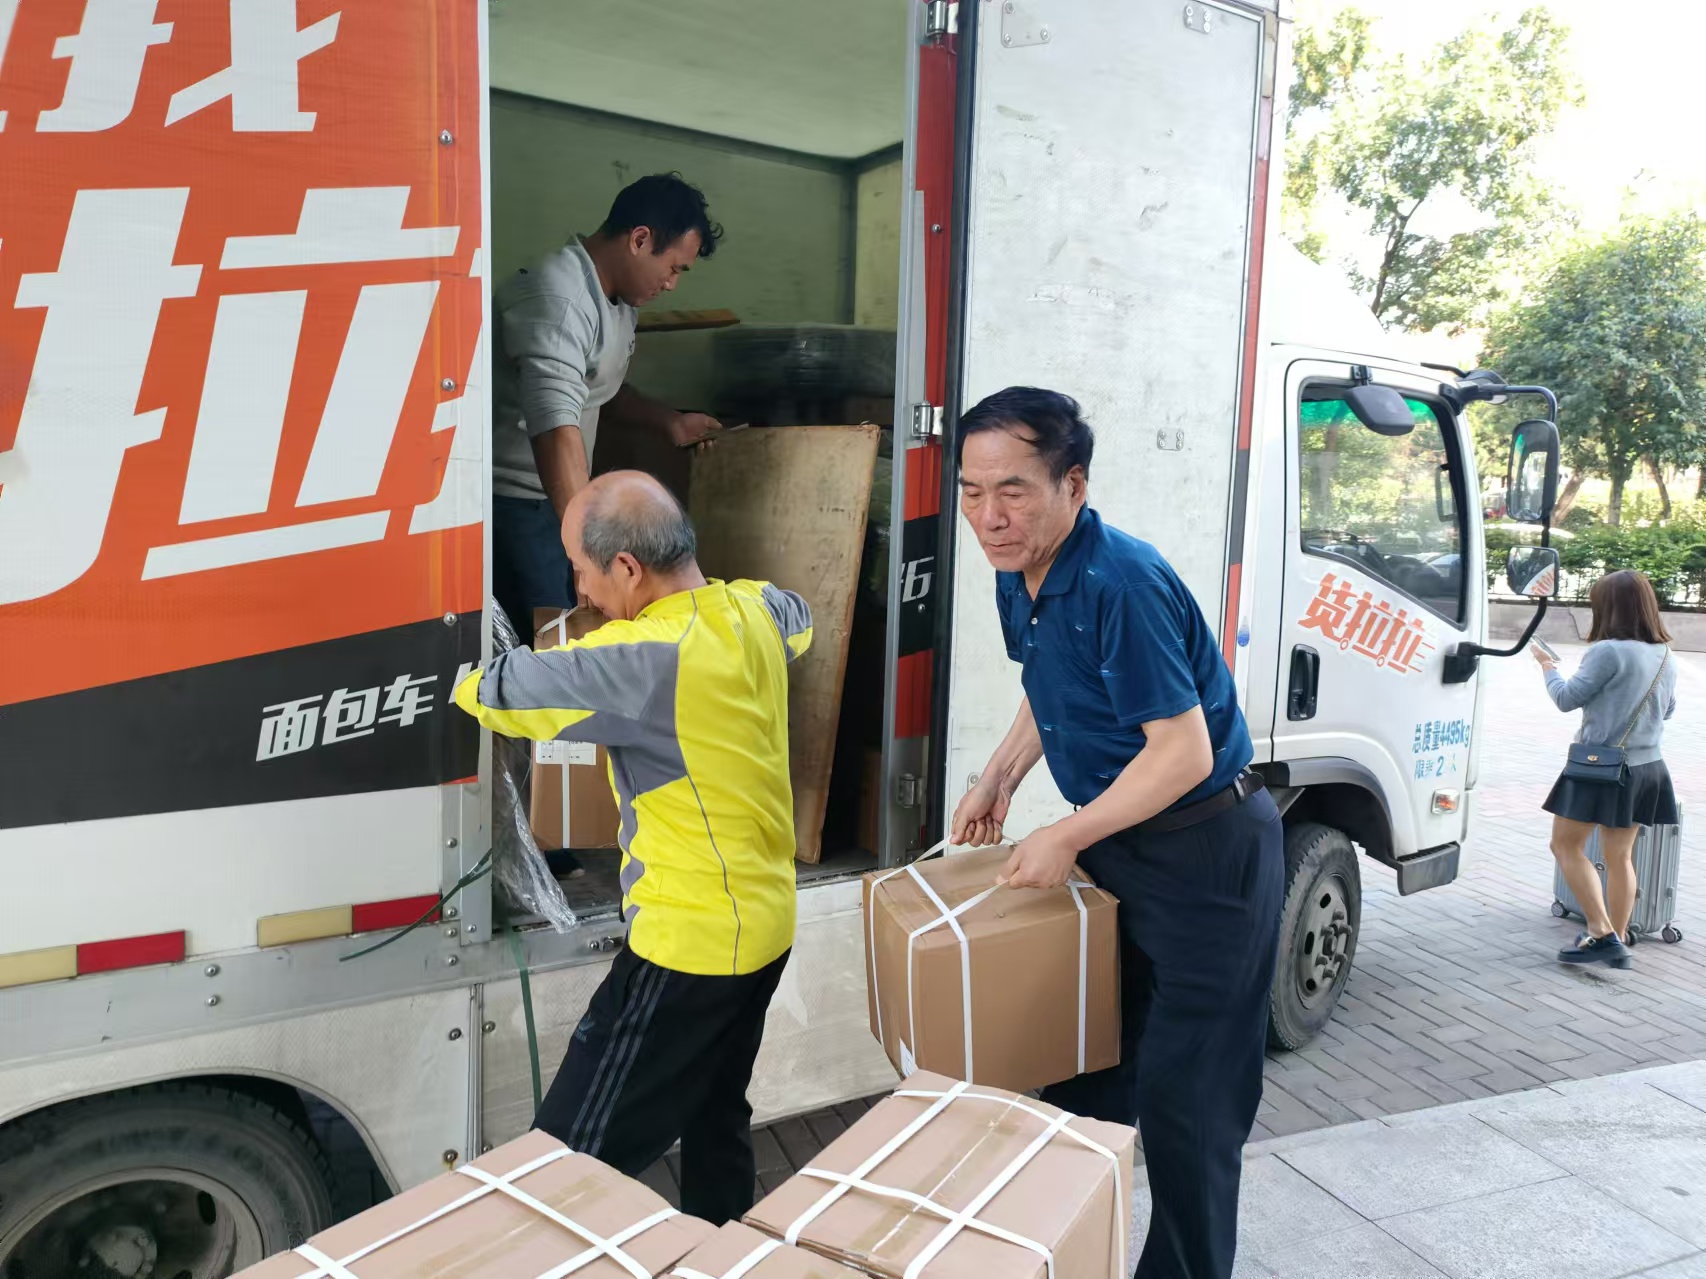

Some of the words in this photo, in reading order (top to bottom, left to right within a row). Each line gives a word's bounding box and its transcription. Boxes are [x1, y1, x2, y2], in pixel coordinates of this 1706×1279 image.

[1298, 573, 1427, 673] 货拉拉
[256, 673, 438, 762] 面包车
